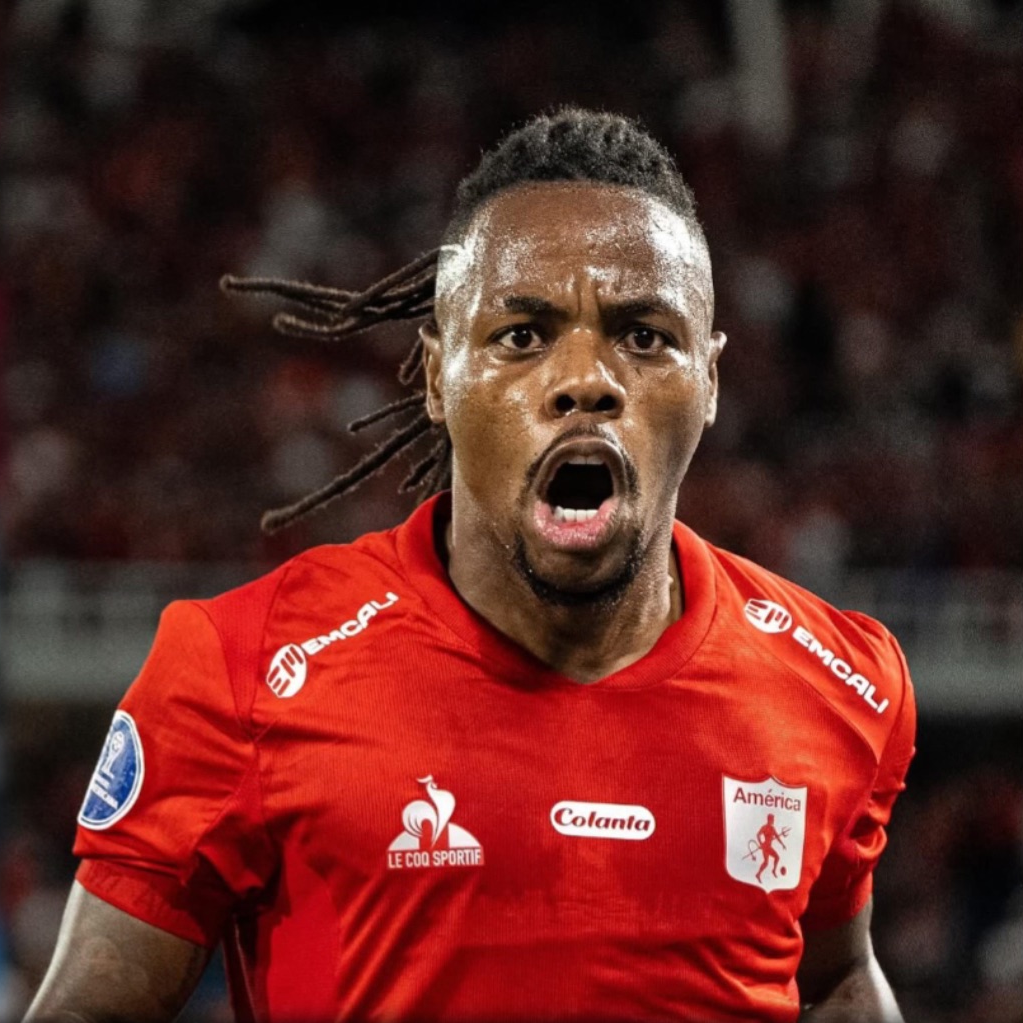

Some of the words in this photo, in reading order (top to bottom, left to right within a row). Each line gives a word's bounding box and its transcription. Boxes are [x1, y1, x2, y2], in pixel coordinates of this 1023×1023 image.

[302, 592, 399, 655] EMCALI
[792, 625, 889, 714] EMCALI
[733, 787, 802, 812] América
[553, 807, 651, 833] Colanta
[388, 853, 403, 868] LE
[405, 850, 430, 867] COQ
[433, 849, 483, 866] SPORTIF
